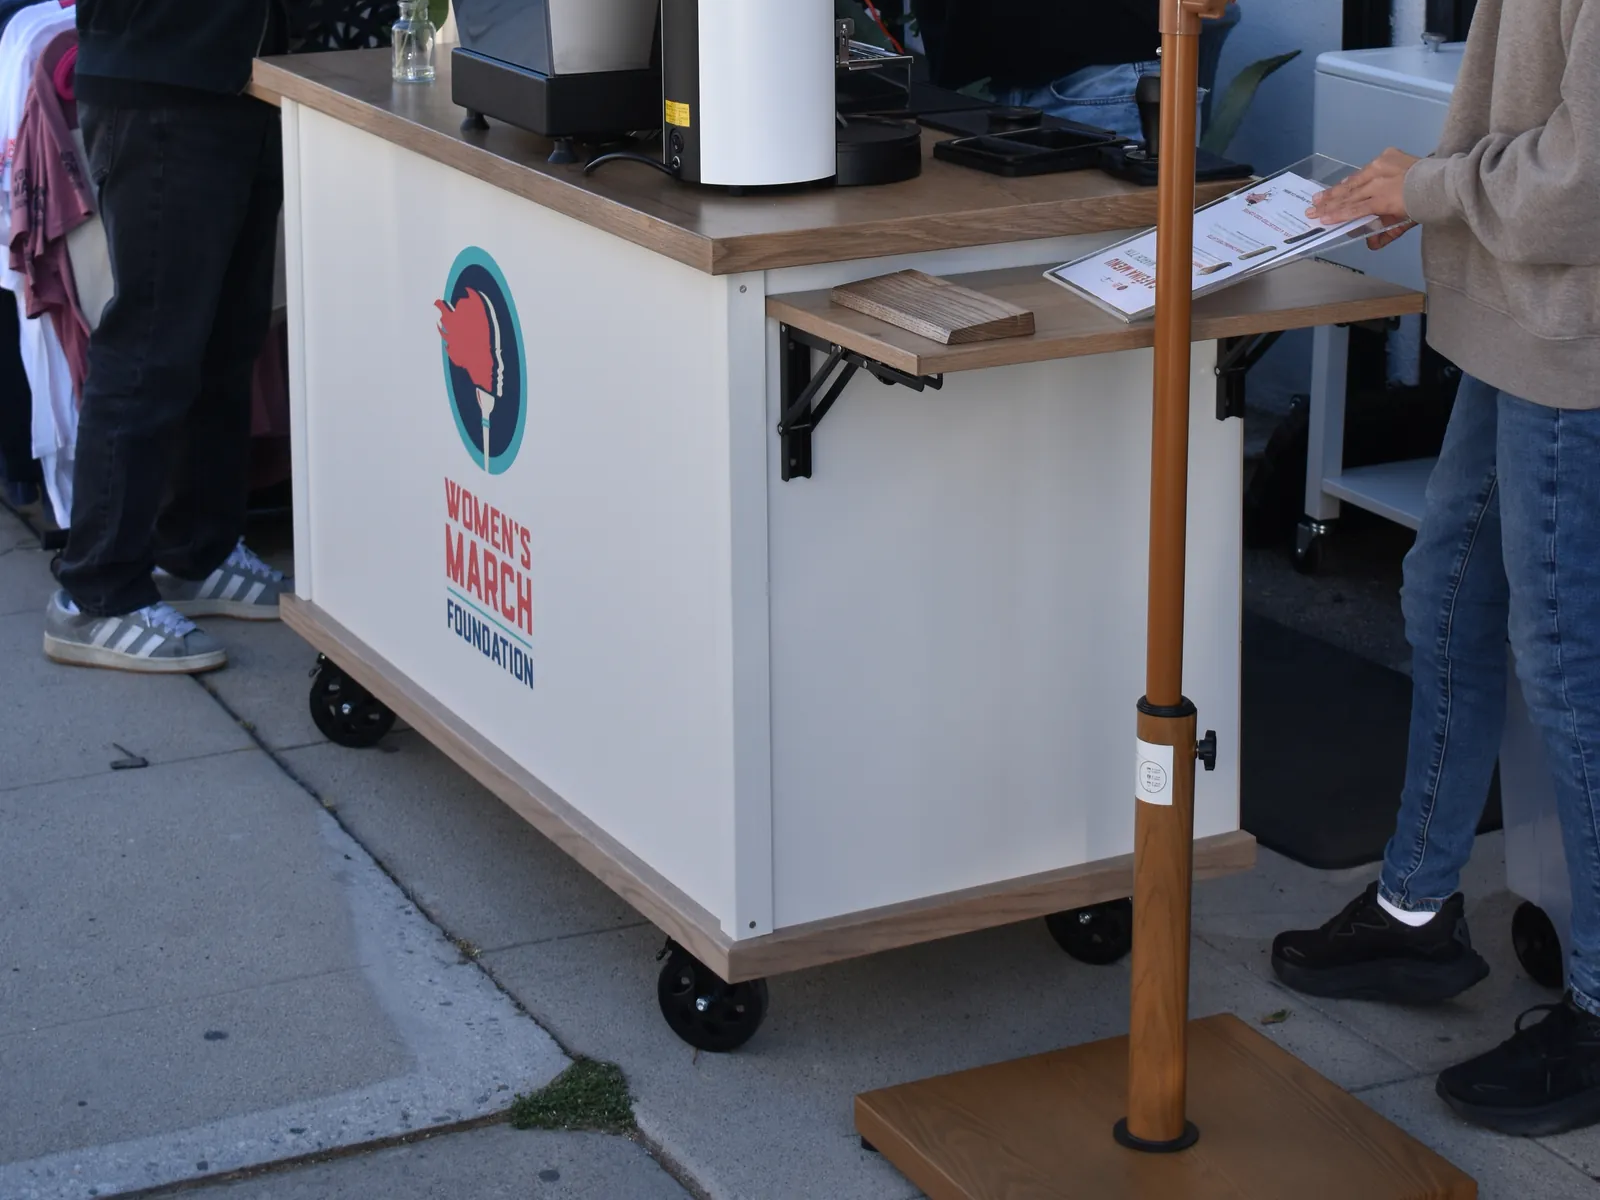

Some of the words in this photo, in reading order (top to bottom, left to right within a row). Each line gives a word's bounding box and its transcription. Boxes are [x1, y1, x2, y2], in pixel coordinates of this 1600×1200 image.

[444, 476, 531, 571] WOMEN'S
[445, 523, 533, 636] MARCH
[447, 598, 534, 690] FOUNDATION
